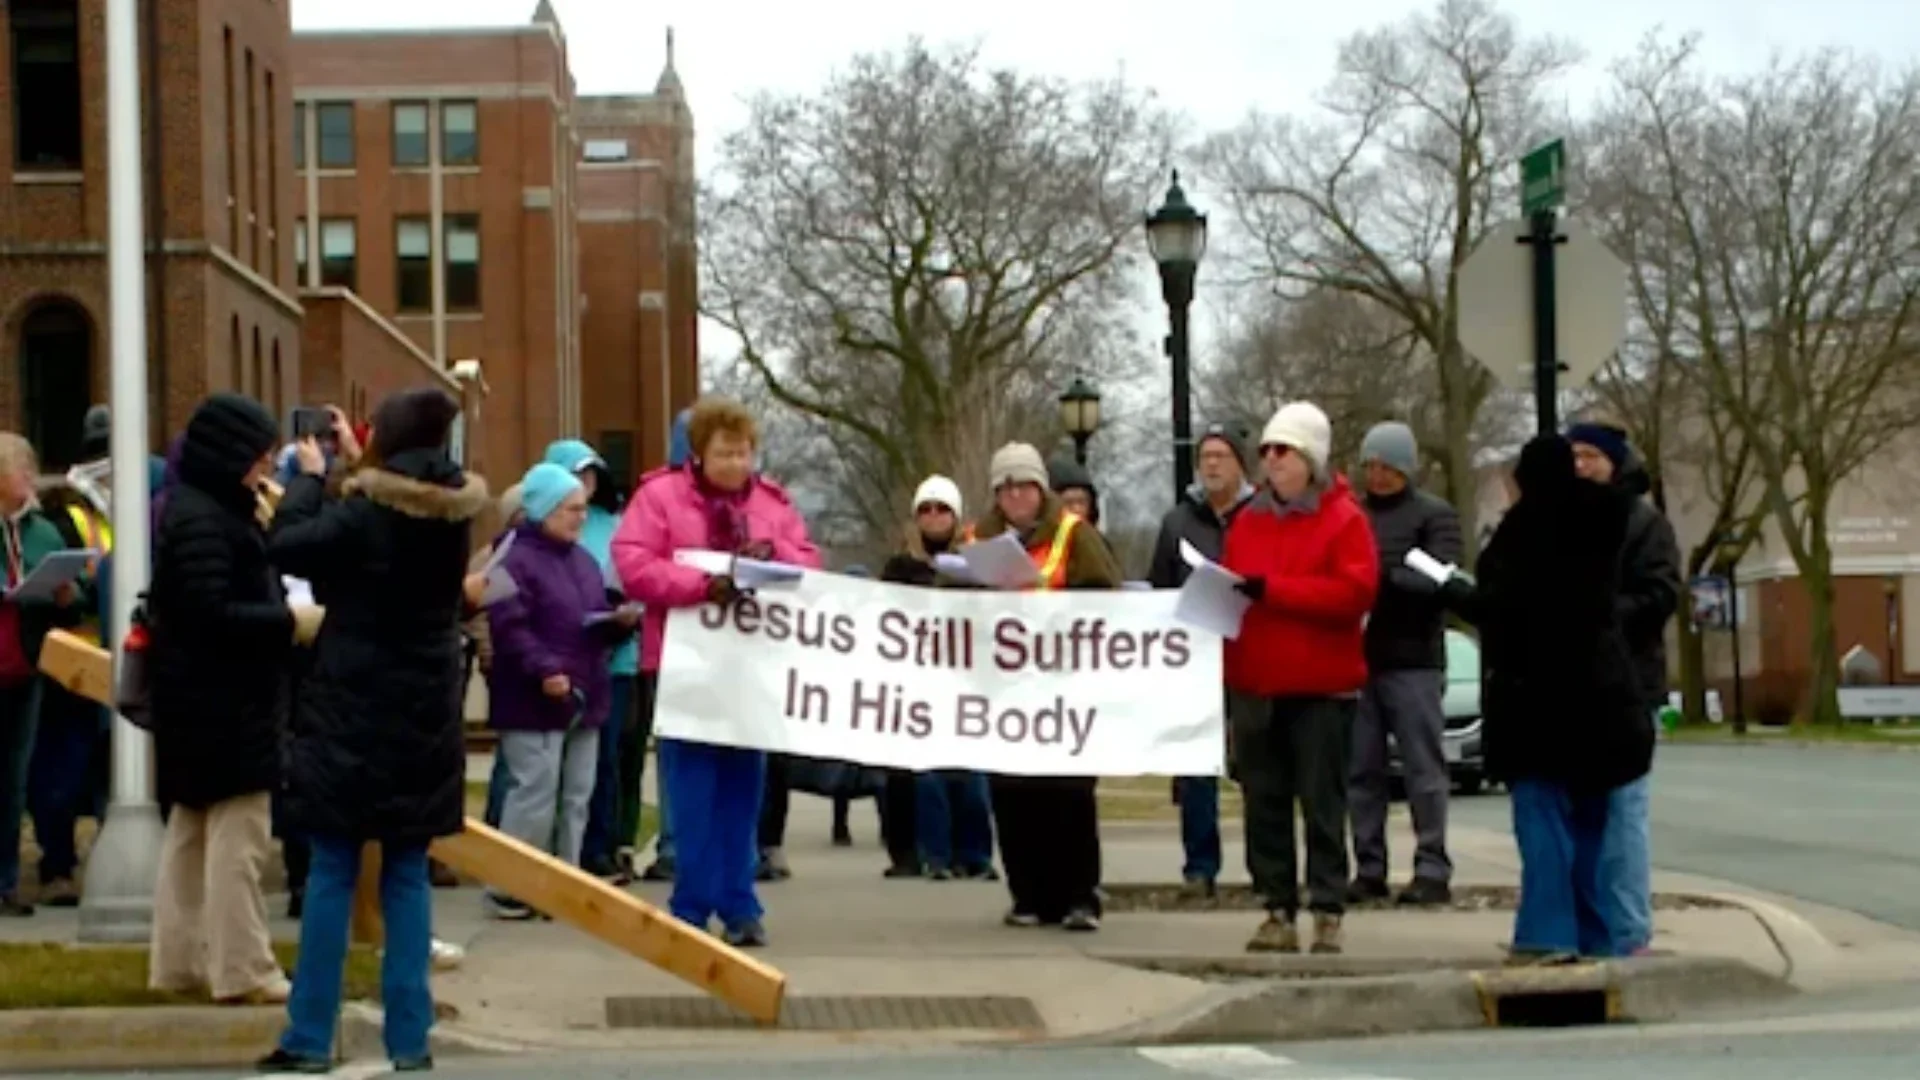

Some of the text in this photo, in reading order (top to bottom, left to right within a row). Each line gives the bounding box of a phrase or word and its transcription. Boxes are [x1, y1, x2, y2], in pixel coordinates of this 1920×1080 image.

[877, 611, 974, 671] Still
[992, 619, 1191, 672] Suffers
[784, 668, 1097, 756] In His Body
